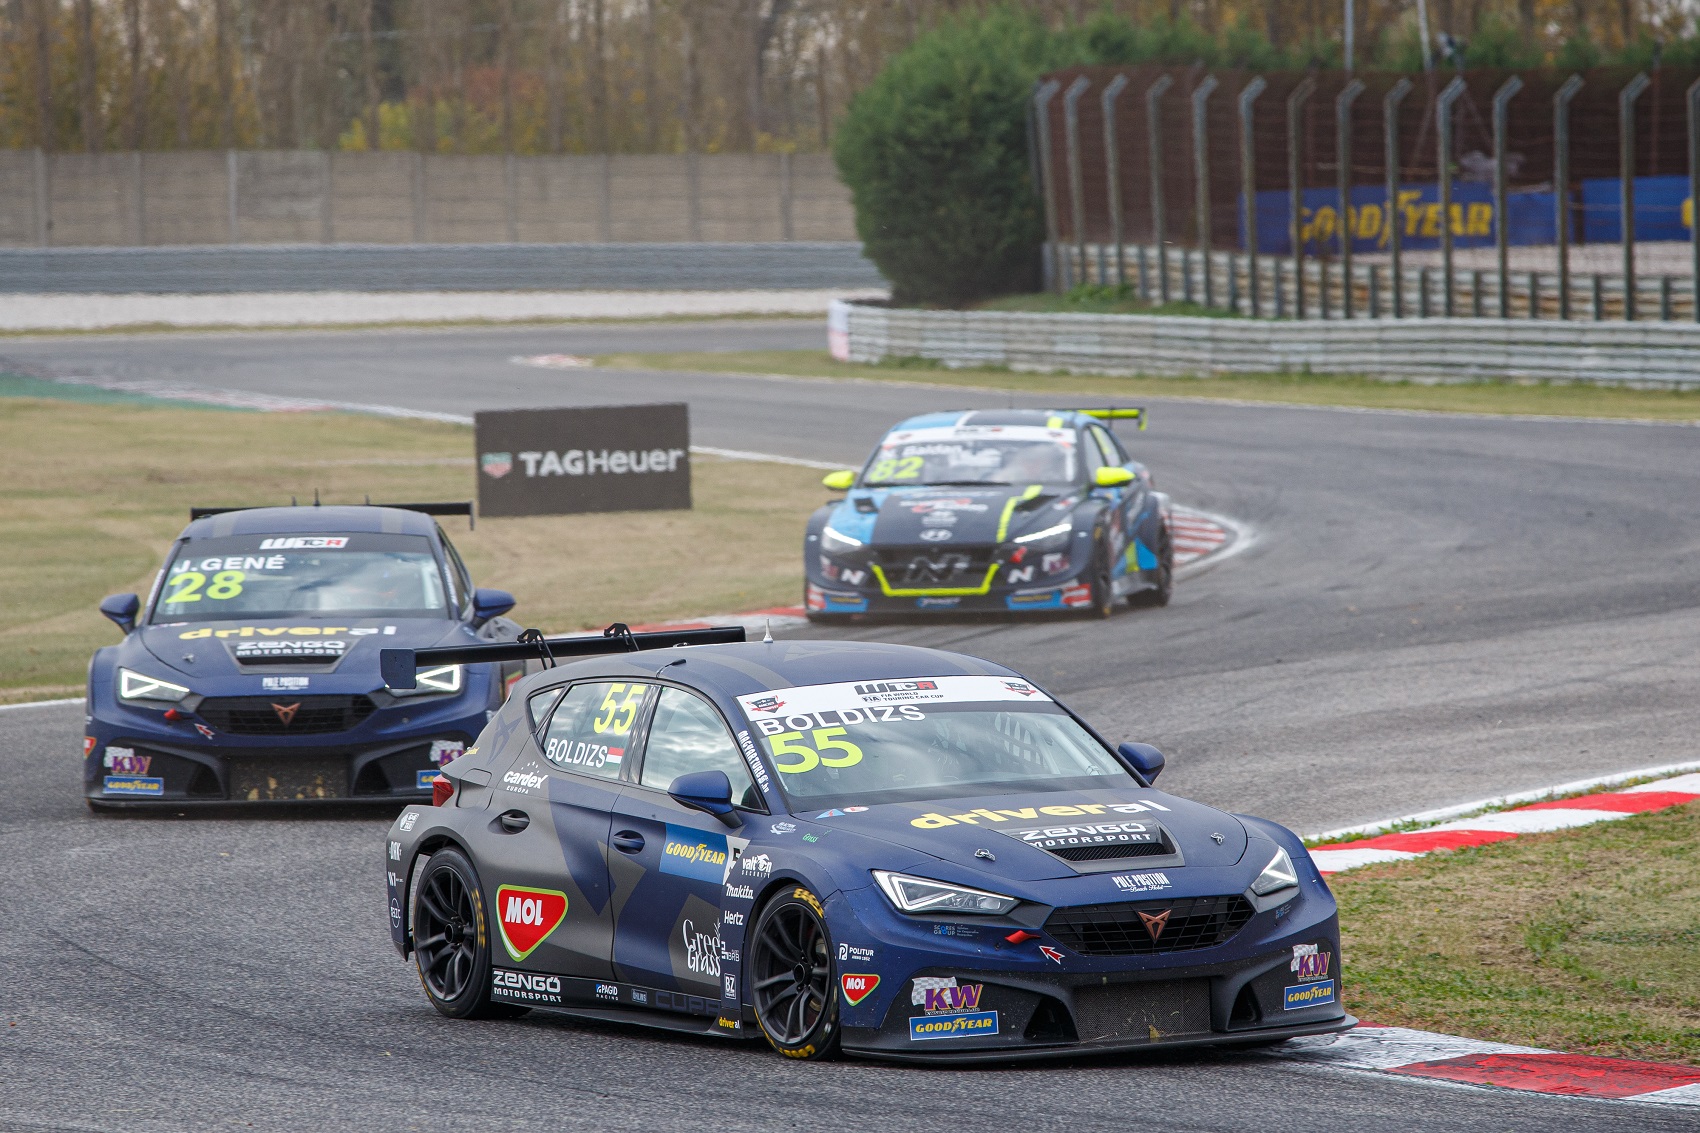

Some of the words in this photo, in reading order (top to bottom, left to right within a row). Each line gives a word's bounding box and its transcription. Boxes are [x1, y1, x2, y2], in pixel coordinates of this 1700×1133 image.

[869, 456, 925, 482] 82
[173, 555, 287, 573] J.GENÉ
[165, 570, 246, 604] 28
[593, 682, 647, 735] 55
[755, 705, 927, 736] BOLDIZS
[545, 738, 608, 768] BOLDIZS
[768, 727, 863, 773] 55
[503, 769, 549, 789] cardex
[1030, 833, 1151, 848] MOTORSPORT
[665, 842, 727, 865] GOODYEAR
[1111, 875, 1137, 889] POLE
[505, 896, 544, 926] MOL
[723, 910, 744, 926] Hertz
[1298, 952, 1331, 978] KW
[493, 987, 563, 1003] MOTORSPORT
[845, 977, 866, 990] MOL
[1287, 986, 1332, 1003] GOODYEAR
[924, 984, 984, 1011] KW
[915, 1017, 993, 1033] GOODYEAR
